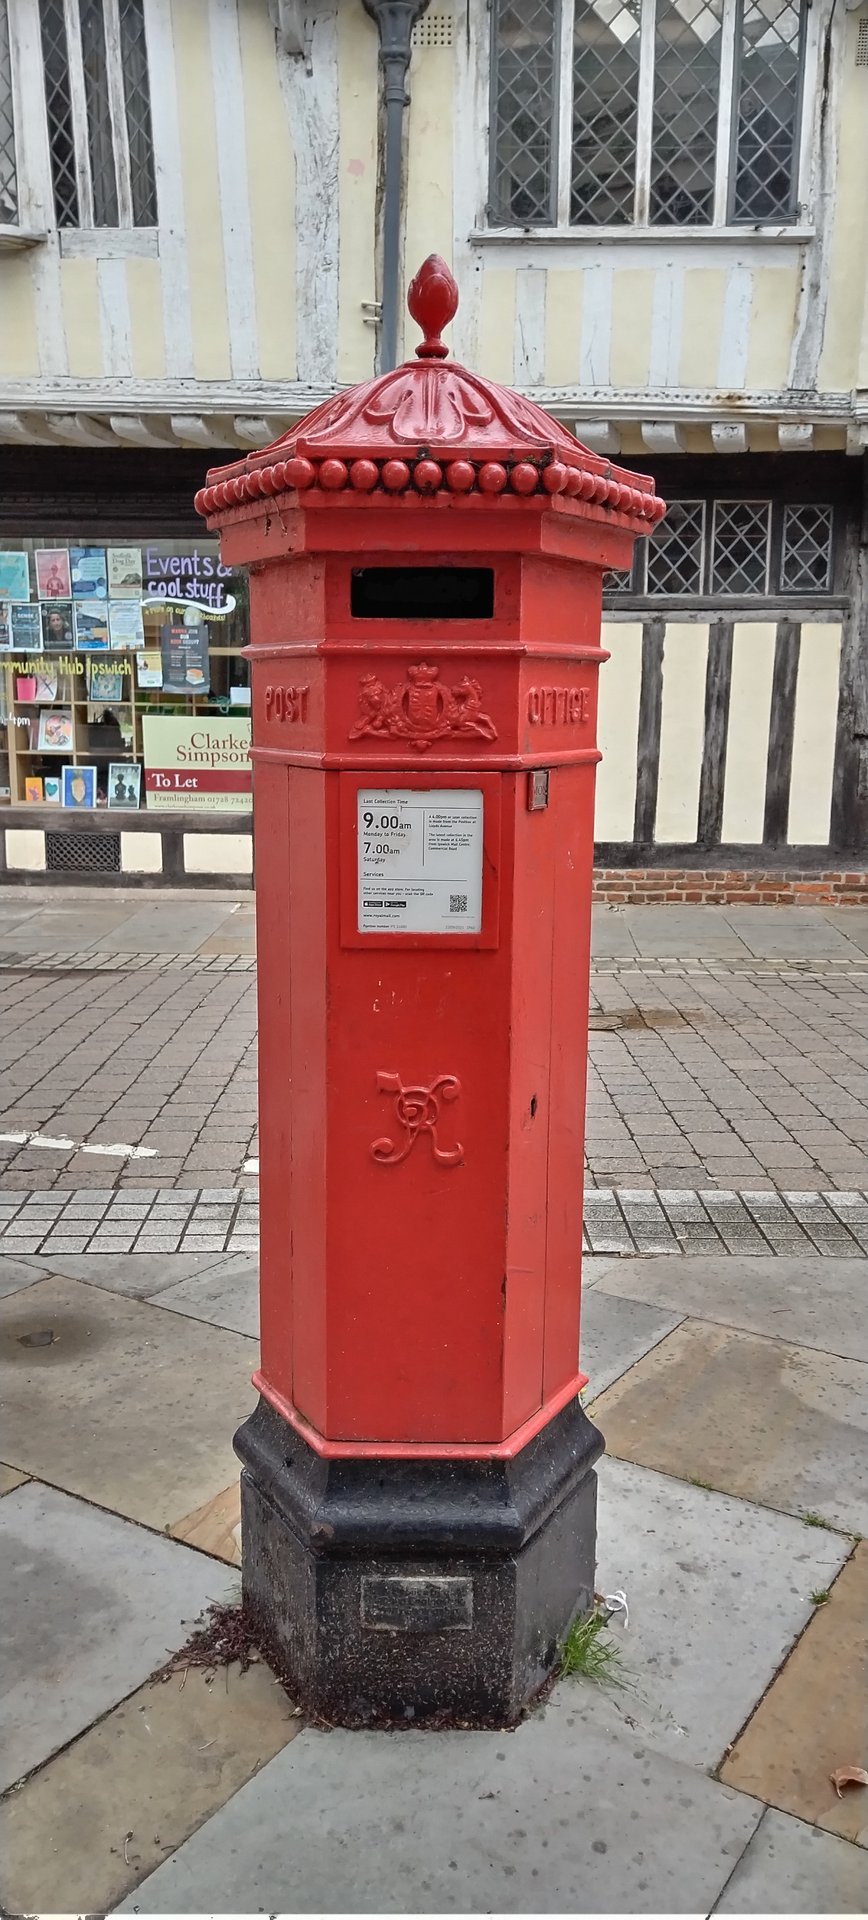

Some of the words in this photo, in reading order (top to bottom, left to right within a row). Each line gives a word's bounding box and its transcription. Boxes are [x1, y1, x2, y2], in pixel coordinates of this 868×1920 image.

[146, 547, 214, 577] Events
[147, 577, 184, 598] cool
[185, 577, 225, 609] stuff
[59, 656, 84, 676] Hub
[87, 657, 132, 680] Ipswich
[264, 686, 310, 724] POST
[528, 686, 590, 725] OFFICE
[190, 732, 248, 750] Clarke
[176, 745, 250, 768] Simpson
[152, 773, 171, 788] To
[174, 773, 198, 788] Let
[154, 793, 205, 804] Framlingham
[207, 795, 229, 805] 01728
[363, 812, 412, 829] 9.00am
[363, 842, 400, 854] 7.00am
